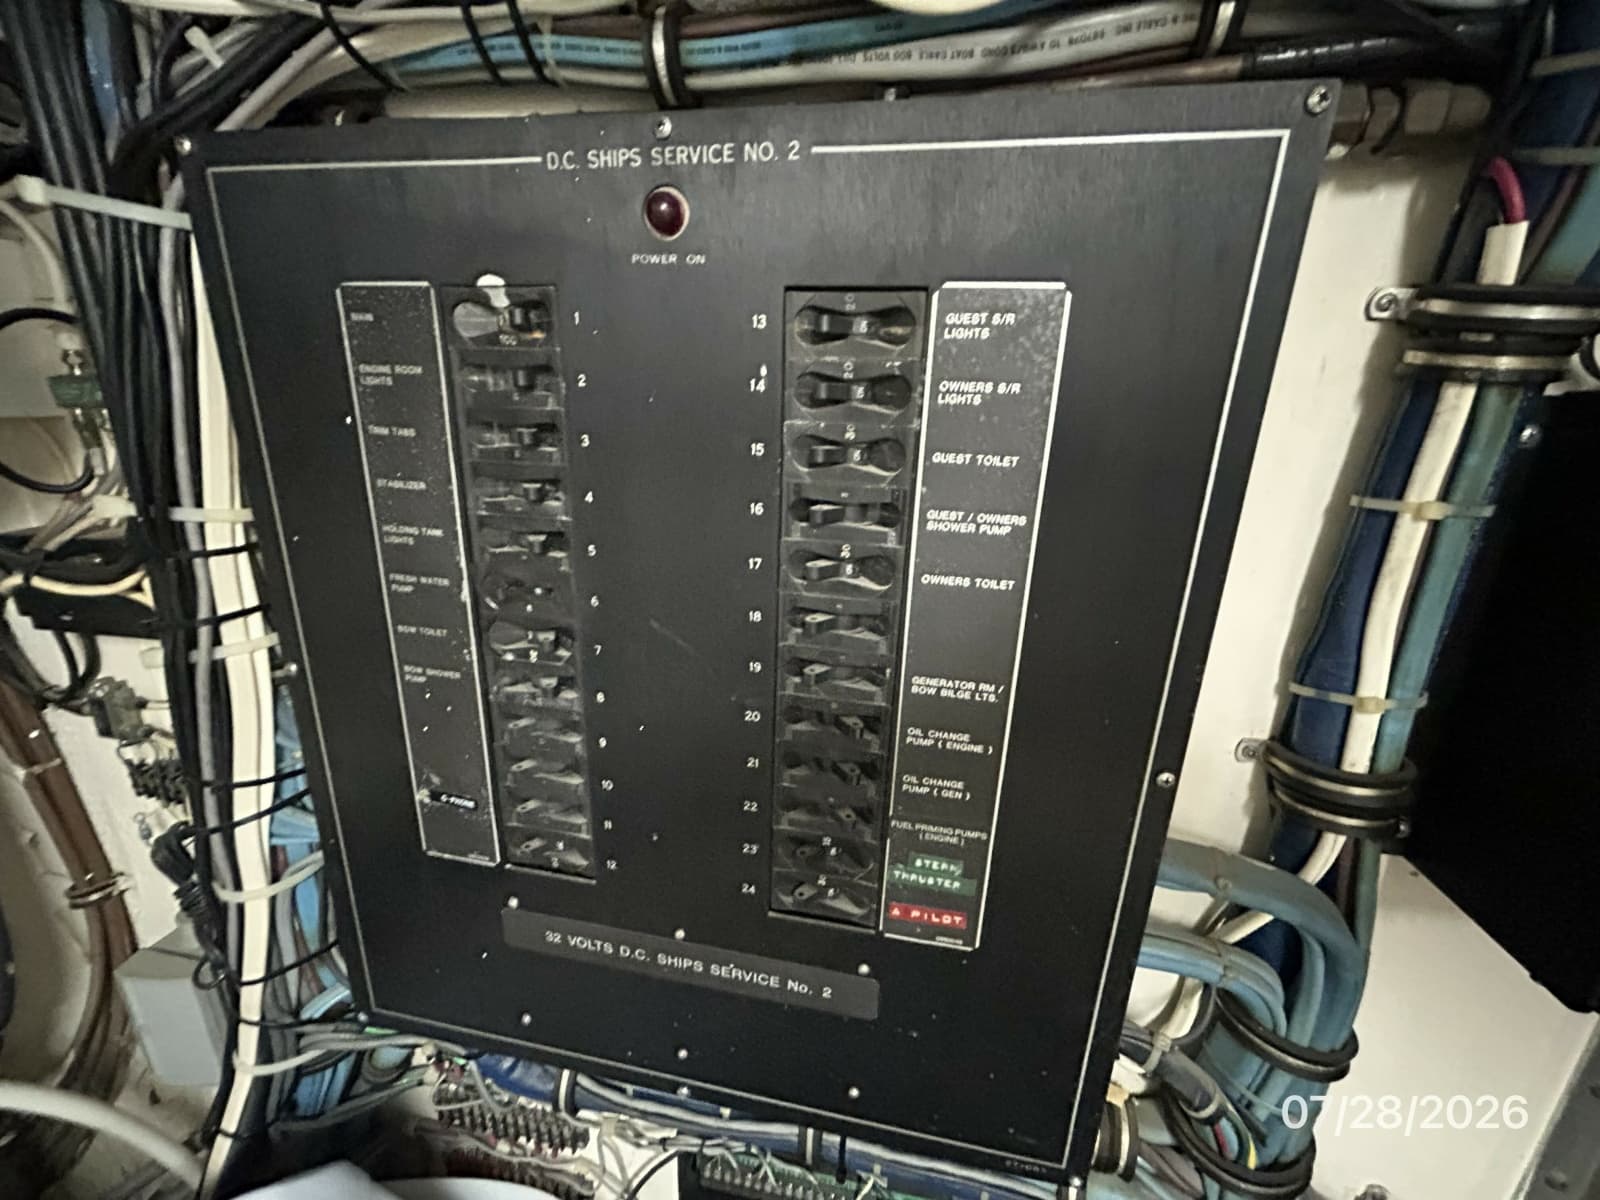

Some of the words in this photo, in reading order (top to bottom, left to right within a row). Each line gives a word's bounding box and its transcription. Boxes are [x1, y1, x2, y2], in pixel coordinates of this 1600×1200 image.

[546, 151, 580, 170] D.C.
[587, 148, 642, 169] SHIPS
[651, 143, 735, 166] SERVICE
[744, 141, 778, 162] NO.
[788, 140, 800, 160] 2
[631, 254, 677, 264] POWER
[686, 254, 706, 264] ON
[574, 312, 580, 325] 1
[752, 314, 767, 329] 13
[945, 312, 989, 325] GUEST
[944, 327, 990, 339] LIGHTS
[577, 374, 587, 387] 2
[750, 378, 766, 392] 14
[939, 381, 994, 394] OWNERS
[937, 394, 982, 406] LIGHTS
[580, 434, 590, 447] 3
[751, 443, 765, 456] 15
[932, 452, 973, 465] GUEST
[976, 455, 1020, 467] TOILET
[376, 478, 427, 490] STABILIZER
[585, 491, 594, 503] 4
[750, 502, 764, 515] 16
[926, 509, 965, 522] GUEST
[977, 514, 1027, 526] OWNERS
[382, 524, 419, 535] HOLDING
[926, 521, 976, 534] SHOWER
[979, 524, 1012, 536] PUMP
[587, 545, 596, 556] 5
[749, 558, 762, 570] 17
[389, 573, 418, 584] FRESH
[420, 576, 450, 586] WATER
[921, 574, 971, 587] OWNERS
[974, 577, 1015, 590] TOILET
[590, 595, 599, 607] 6
[749, 611, 762, 623] 18
[420, 627, 448, 637] TOILET
[593, 645, 602, 656] 7
[426, 667, 461, 679] SHOWER
[749, 661, 762, 673] 19
[911, 675, 976, 690] GENERATOR
[978, 682, 995, 692] RM
[596, 692, 605, 703] 8
[911, 685, 938, 696] BOW
[940, 688, 972, 700] BILGE
[744, 711, 761, 722] 20
[906, 735, 935, 746] PUMP
[907, 727, 924, 736] OIL
[928, 730, 970, 742] CHANGE
[746, 757, 759, 768] 21
[601, 779, 614, 791] 10
[902, 774, 919, 784] OIL
[922, 777, 964, 790] CHANGE
[902, 783, 930, 794] PUMP
[743, 801, 759, 812] 22
[890, 820, 914, 830] FUEL
[915, 823, 954, 836] PRIMING
[955, 829, 988, 840] PUMPS
[742, 843, 759, 854] 23
[893, 870, 961, 889] THRUSTER
[741, 883, 756, 894] 24
[891, 907, 900, 916] A
[911, 910, 963, 925] PILOT
[545, 930, 562, 944] 32
[567, 935, 613, 955] VOLTS
[619, 945, 650, 961] D.C.
[657, 953, 704, 972] SHIPS
[710, 965, 780, 988] SERVICE
[787, 979, 813, 995] No.
[822, 987, 832, 999] 2
